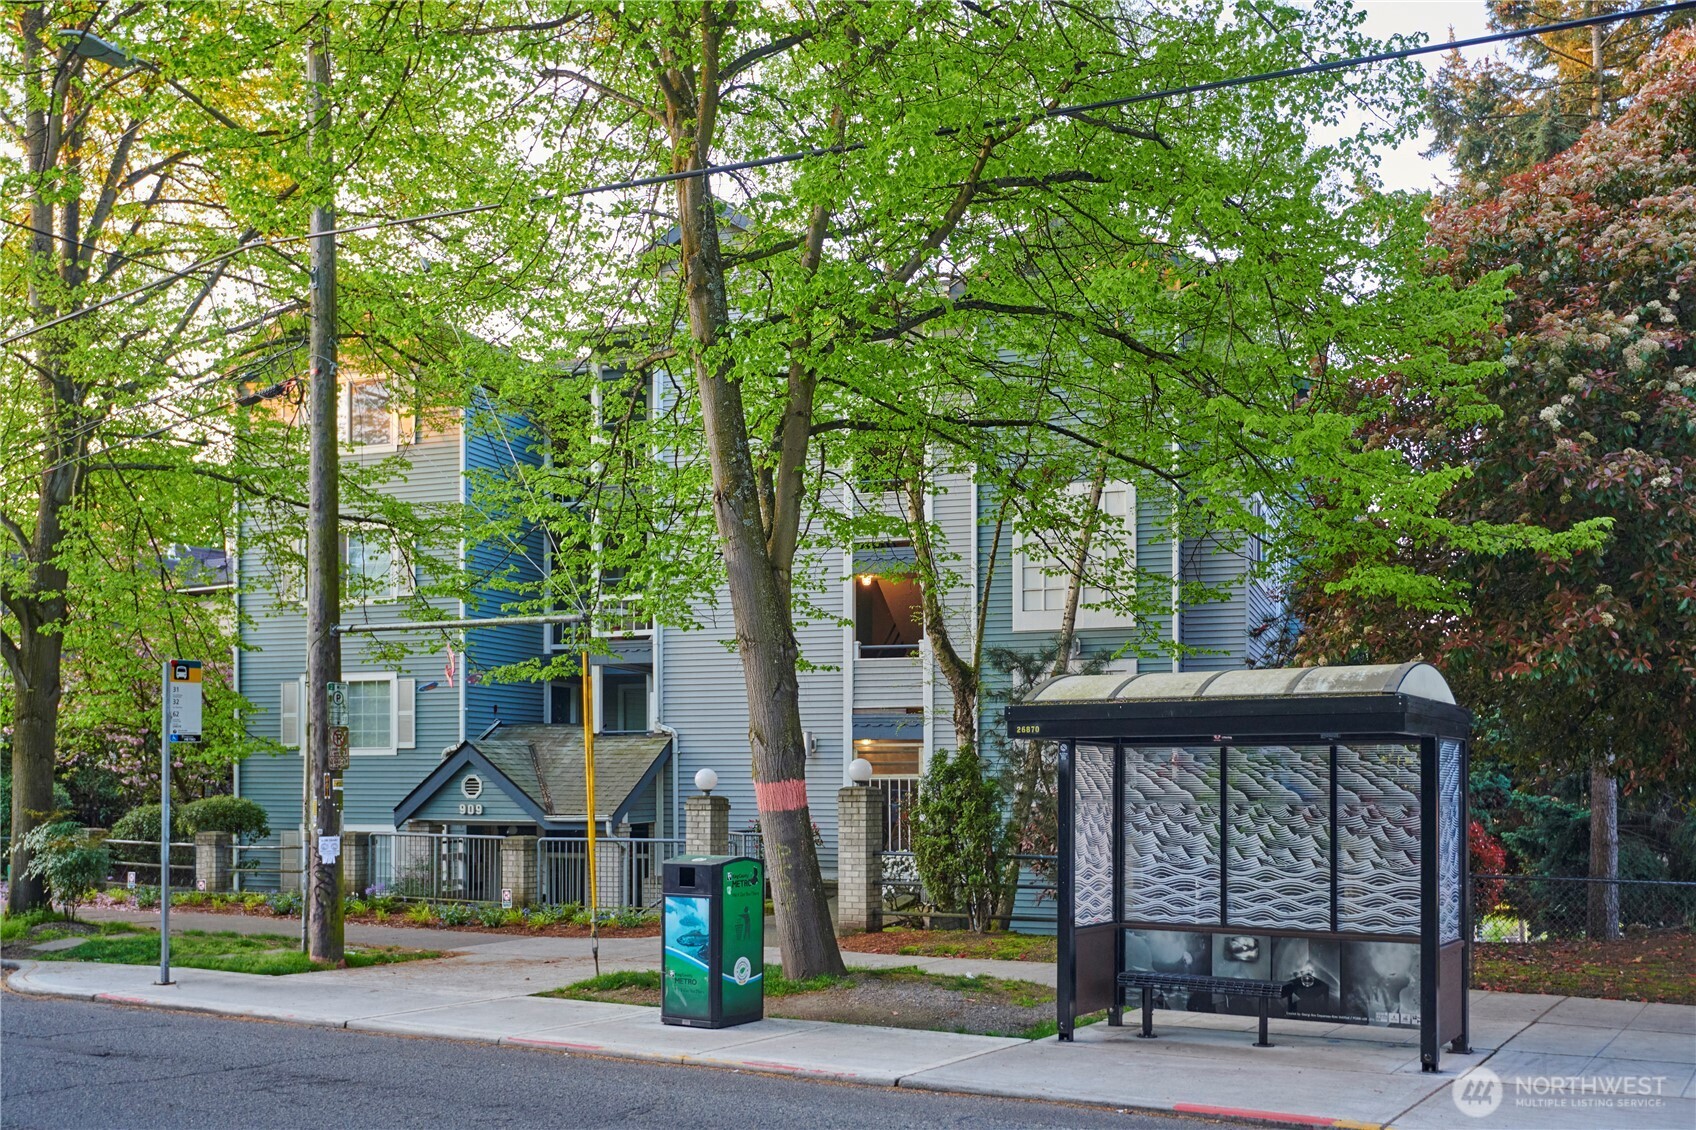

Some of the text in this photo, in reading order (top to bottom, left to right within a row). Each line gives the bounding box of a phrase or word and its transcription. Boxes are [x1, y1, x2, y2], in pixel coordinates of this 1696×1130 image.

[336, 694, 341, 702] P
[459, 804, 482, 815] 909
[675, 978, 697, 986] METRO
